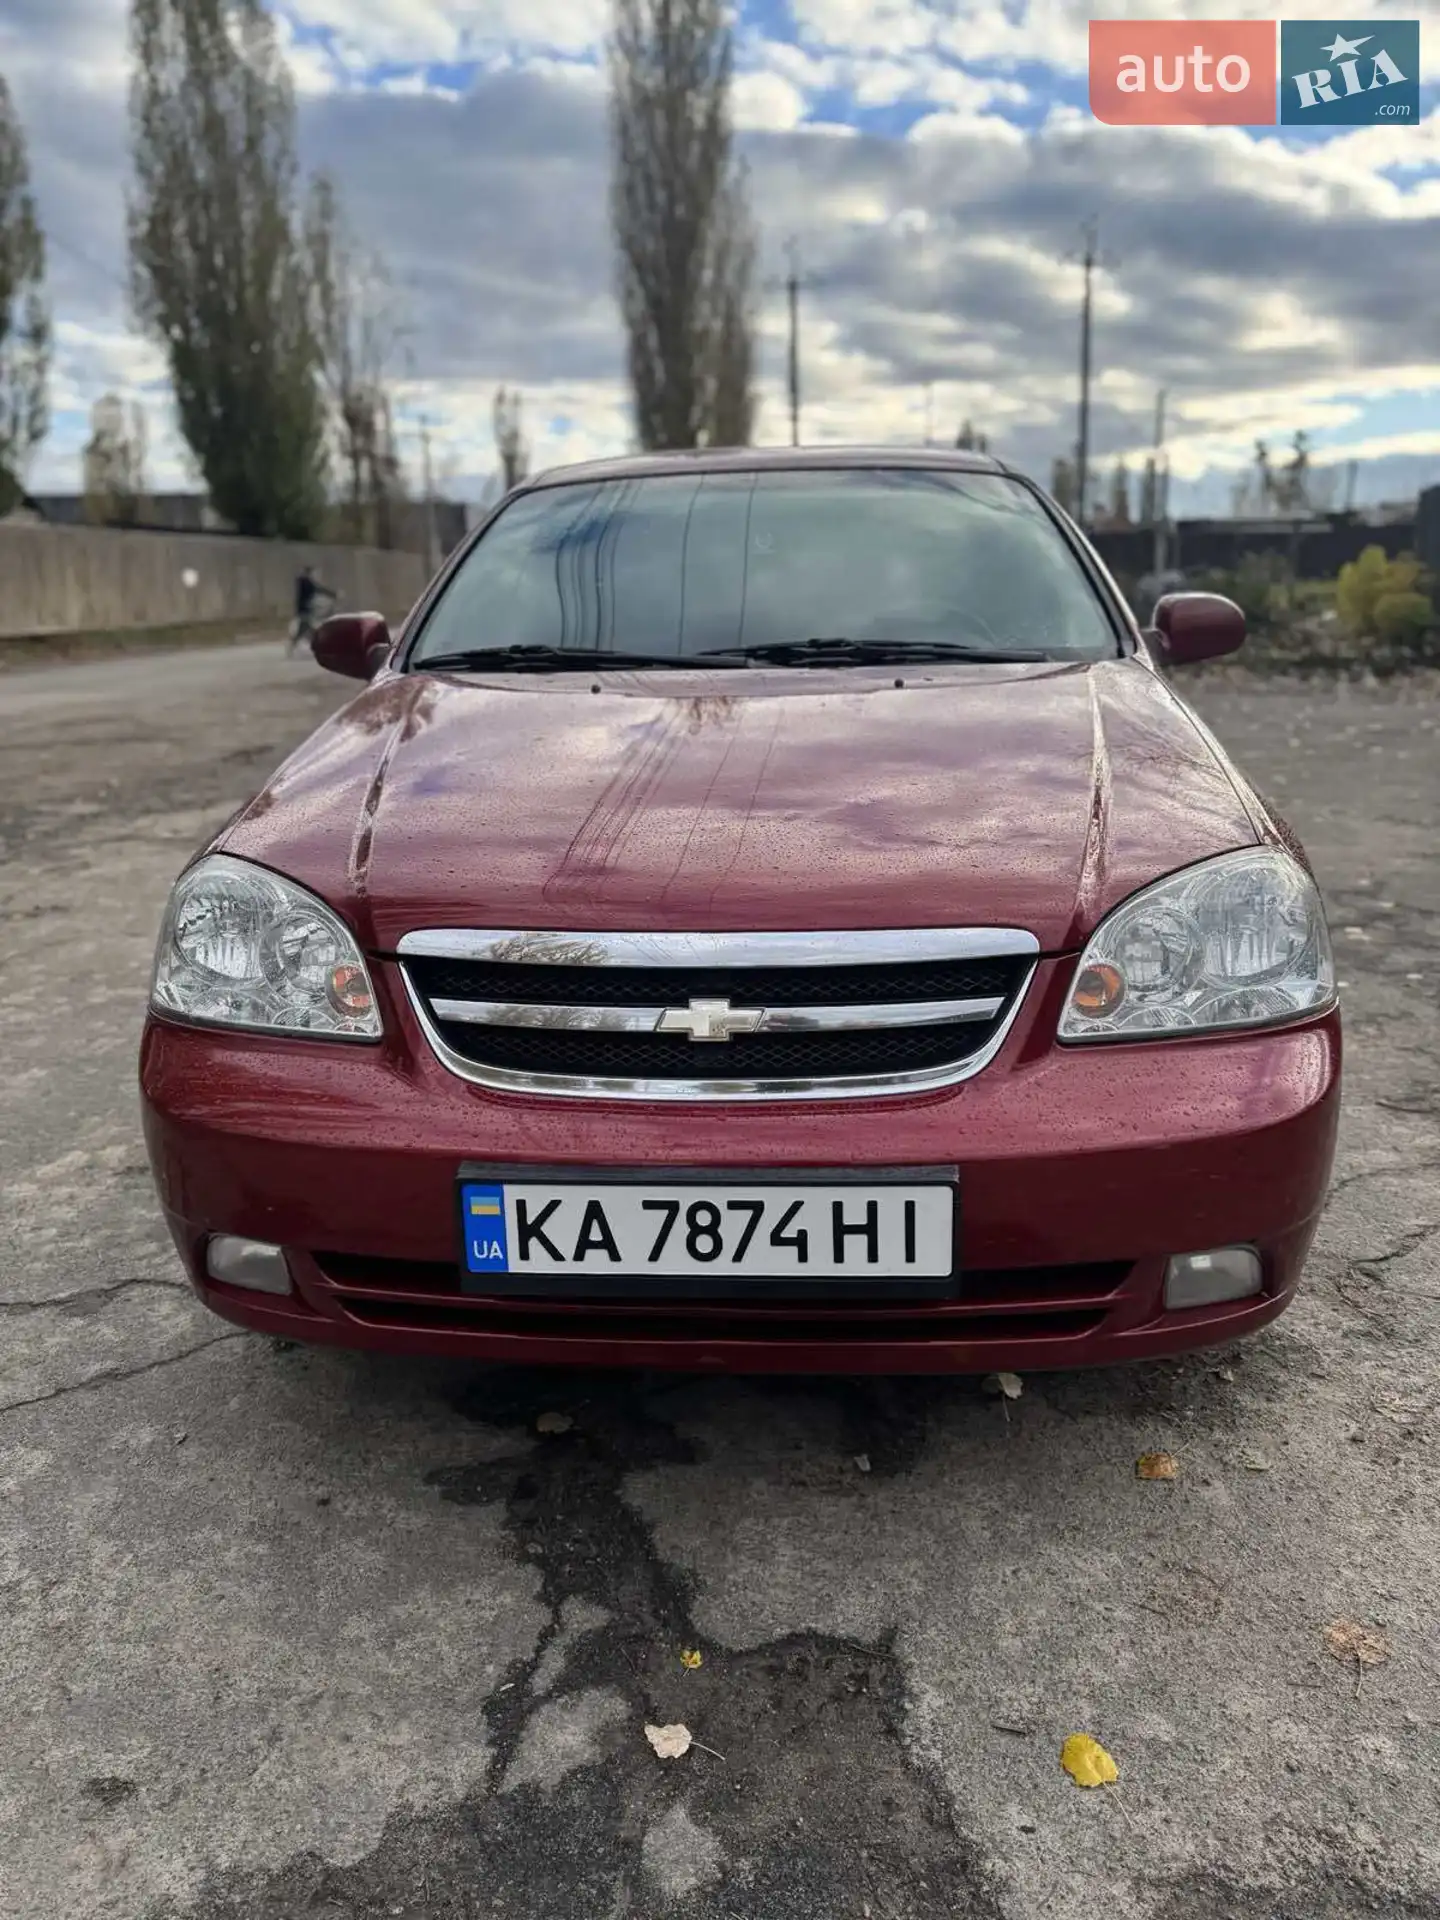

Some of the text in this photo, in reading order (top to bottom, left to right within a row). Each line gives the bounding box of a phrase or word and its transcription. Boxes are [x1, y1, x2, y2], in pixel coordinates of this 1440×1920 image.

[473, 1240, 504, 1260] UA
[515, 1199, 916, 1263] KA 7874 HI
